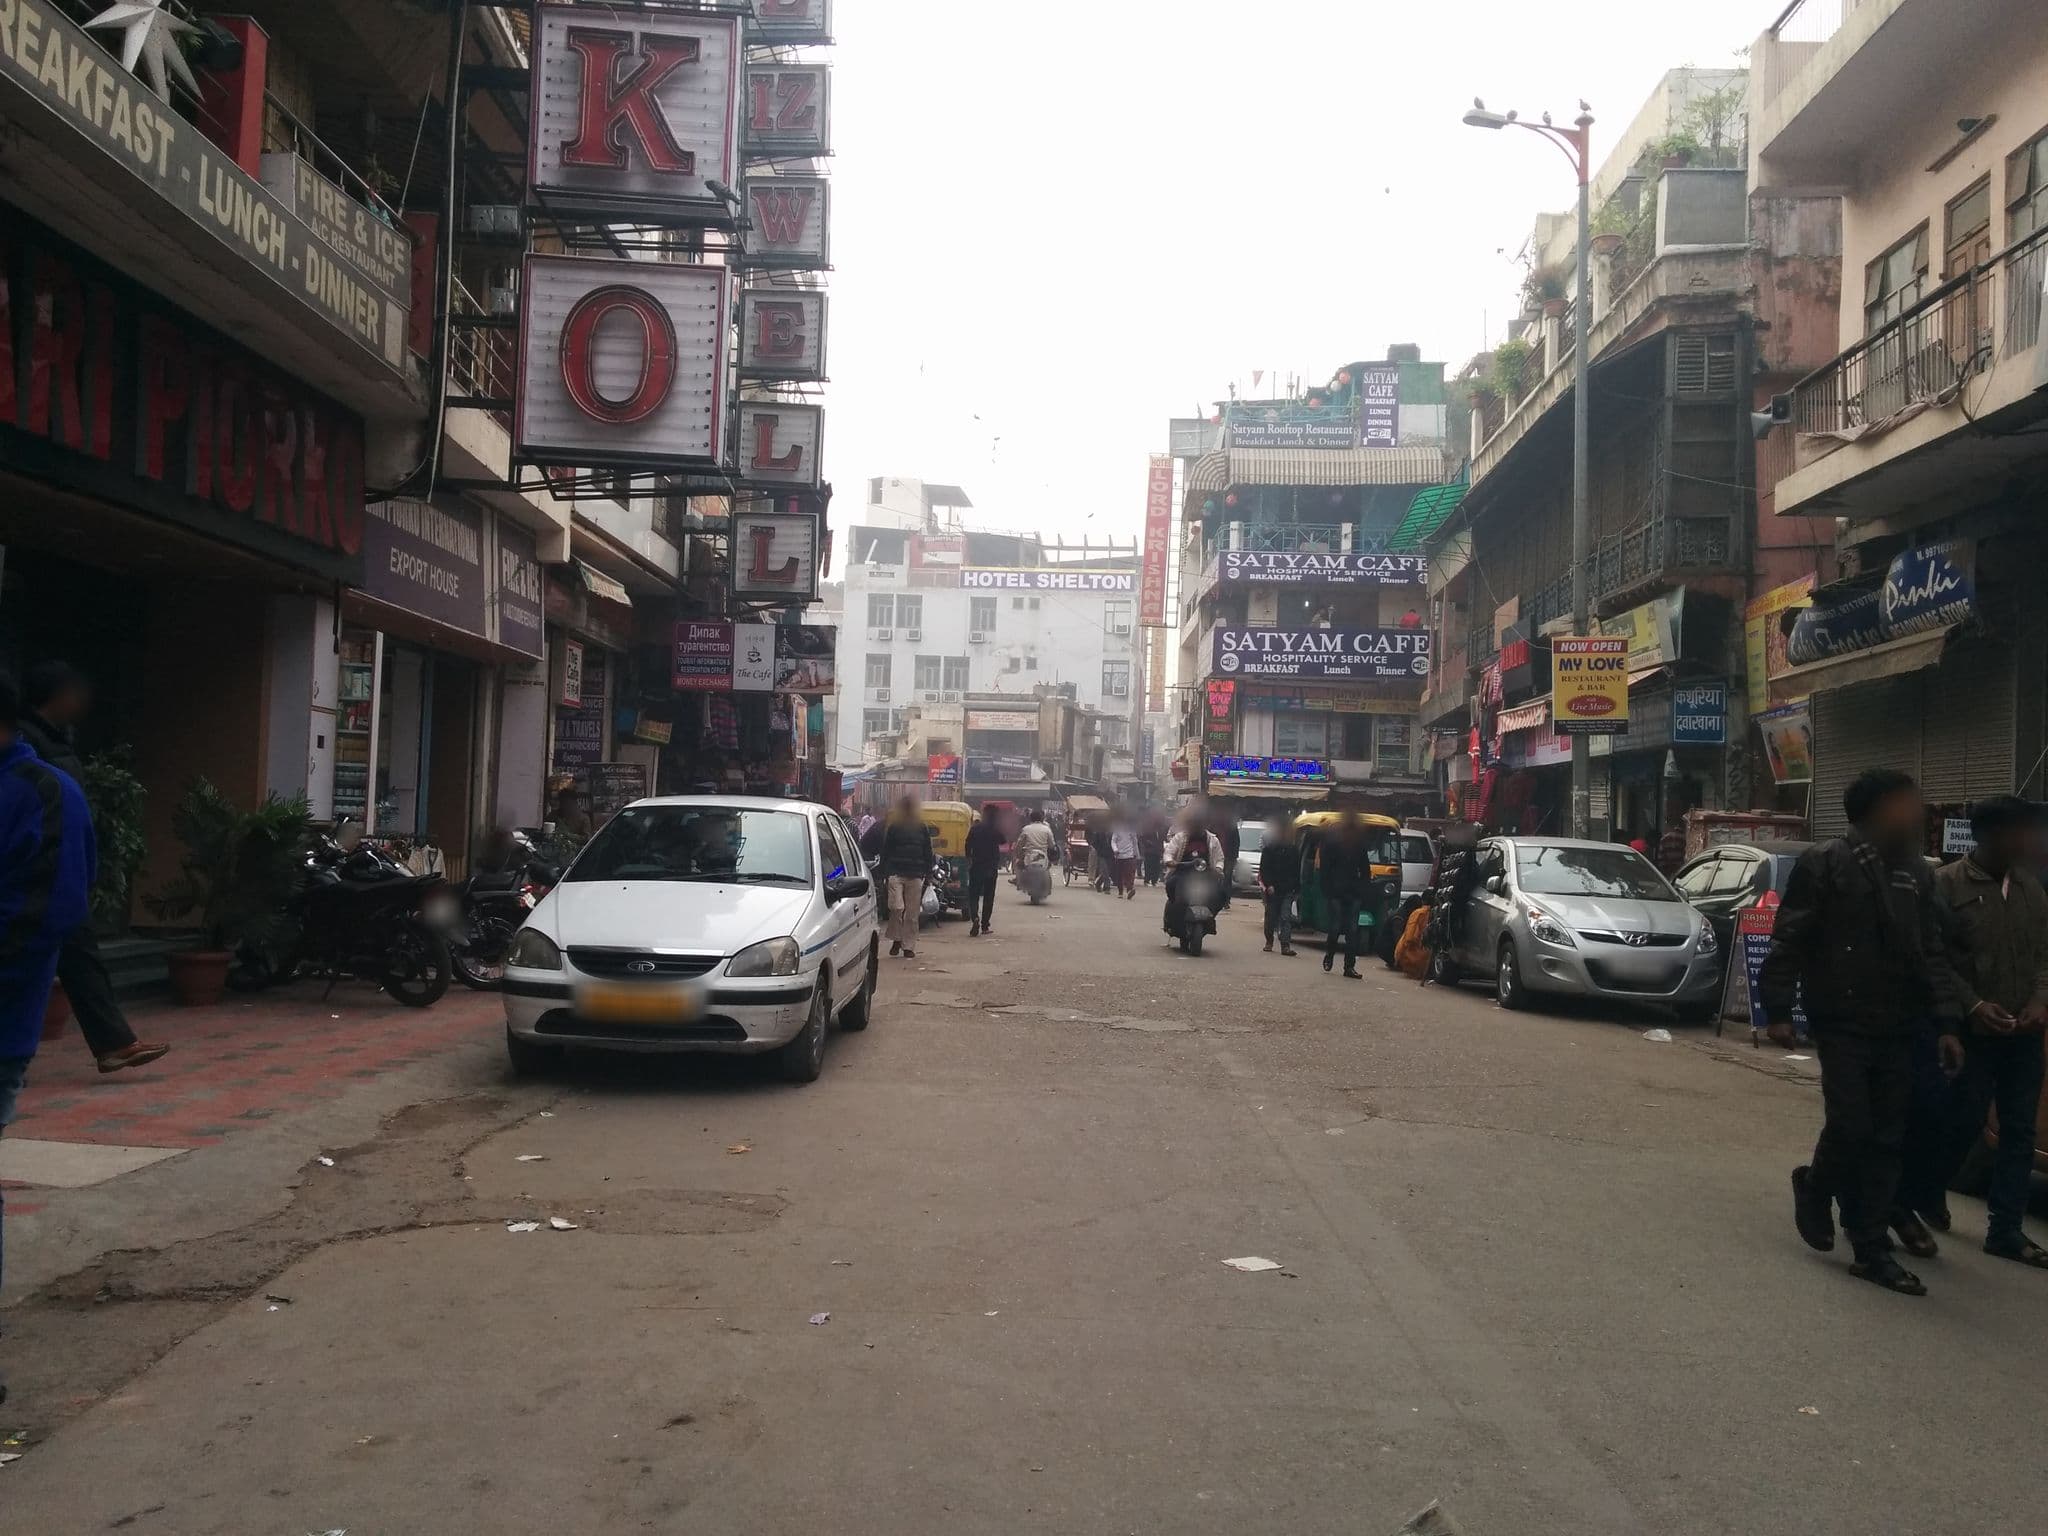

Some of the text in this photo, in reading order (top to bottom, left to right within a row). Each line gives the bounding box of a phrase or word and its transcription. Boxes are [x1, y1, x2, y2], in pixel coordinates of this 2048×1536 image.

[0, 0, 175, 178] REAKFAST
[199, 153, 286, 271] LUNCH
[305, 243, 380, 345] DINNER
[300, 165, 406, 275] FIRE & ICE
[331, 228, 395, 289] RESTAURANT
[1363, 372, 1399, 384] SATYAM
[1368, 384, 1394, 397] CAFE
[1232, 422, 1353, 437] Satyam Rooftop Restaurant
[1235, 437, 1275, 446] Breakfast
[1277, 438, 1304, 446] Lunch
[1318, 438, 1350, 447] Dinner
[1150, 469, 1170, 517] LORD
[1226, 553, 1428, 571] SATYAM CAFE
[390, 547, 460, 599] EXPORT HOUSE
[1249, 573, 1303, 582] BREAKFAST
[1327, 576, 1354, 584] Lunch
[1379, 577, 1409, 585] Dinner
[1267, 568, 1391, 577] HOSPITALITY SERVICE
[963, 572, 1131, 590] HOTEL SHELTON
[1886, 560, 1961, 623] Pinki
[1938, 597, 1971, 625] STORE
[688, 624, 721, 641] Дипак
[678, 641, 731, 654] турагентство
[1222, 632, 1429, 654] SATYAM CAFE
[1560, 641, 1622, 652] NOW OPEN
[1262, 654, 1388, 665] HOSPITALITY SERVICE
[1559, 657, 1583, 671] MY
[1587, 657, 1625, 671] LOVE
[736, 668, 773, 681] The Cafe
[1244, 664, 1407, 676] BREAKFAST Lunch Dinner
[675, 677, 730, 687] MONEY EXCHANGE
[1561, 675, 1622, 683] RESTAURANT
[1571, 702, 1613, 711] Live Music
[1747, 934, 1772, 943] COMP
